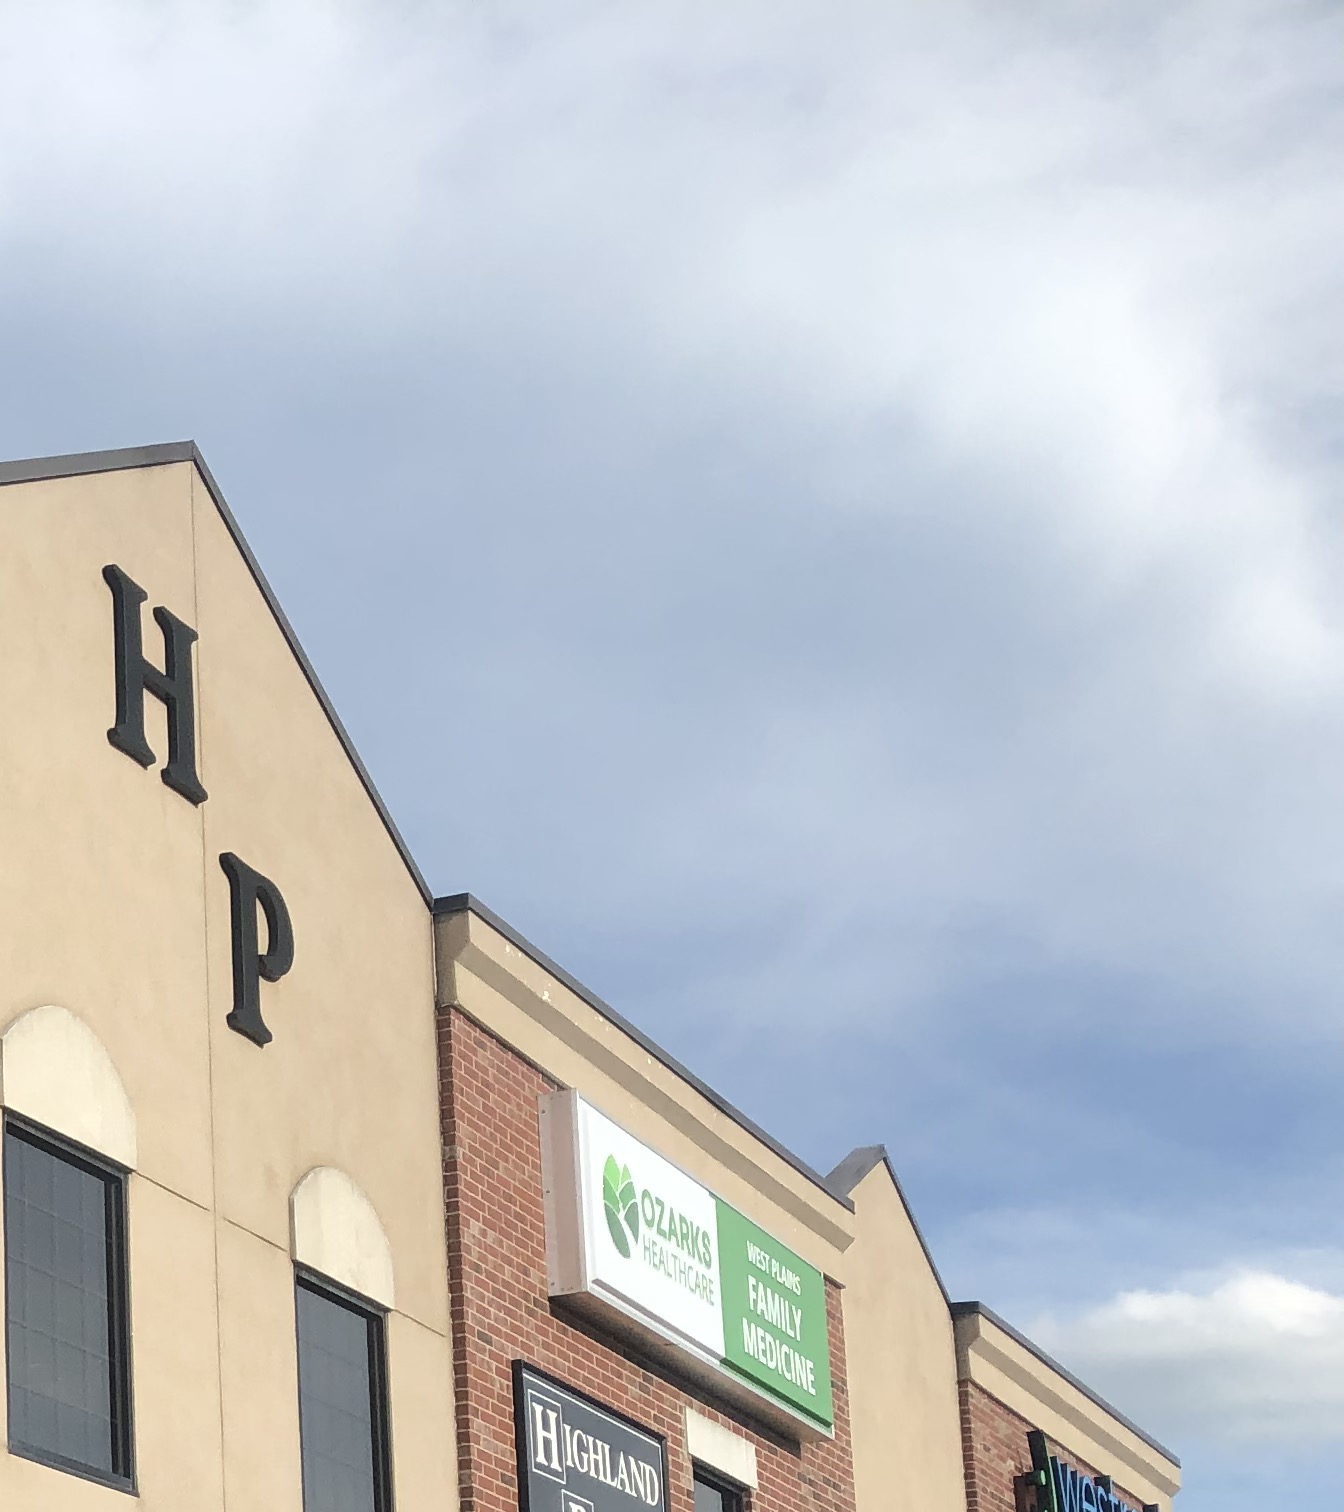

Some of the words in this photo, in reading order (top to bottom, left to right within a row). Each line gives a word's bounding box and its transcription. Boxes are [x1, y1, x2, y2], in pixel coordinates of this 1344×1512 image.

[102, 563, 208, 808] H
[218, 851, 295, 1048] P
[641, 1189, 712, 1271] OZARKS
[642, 1233, 715, 1306] HEALTHCARE
[746, 1240, 769, 1270] WEST
[771, 1258, 801, 1295] PLAINS
[748, 1275, 802, 1343] FAMILY
[742, 1317, 816, 1396] MEDICINE
[532, 1403, 659, 1507] HIGHLAND
